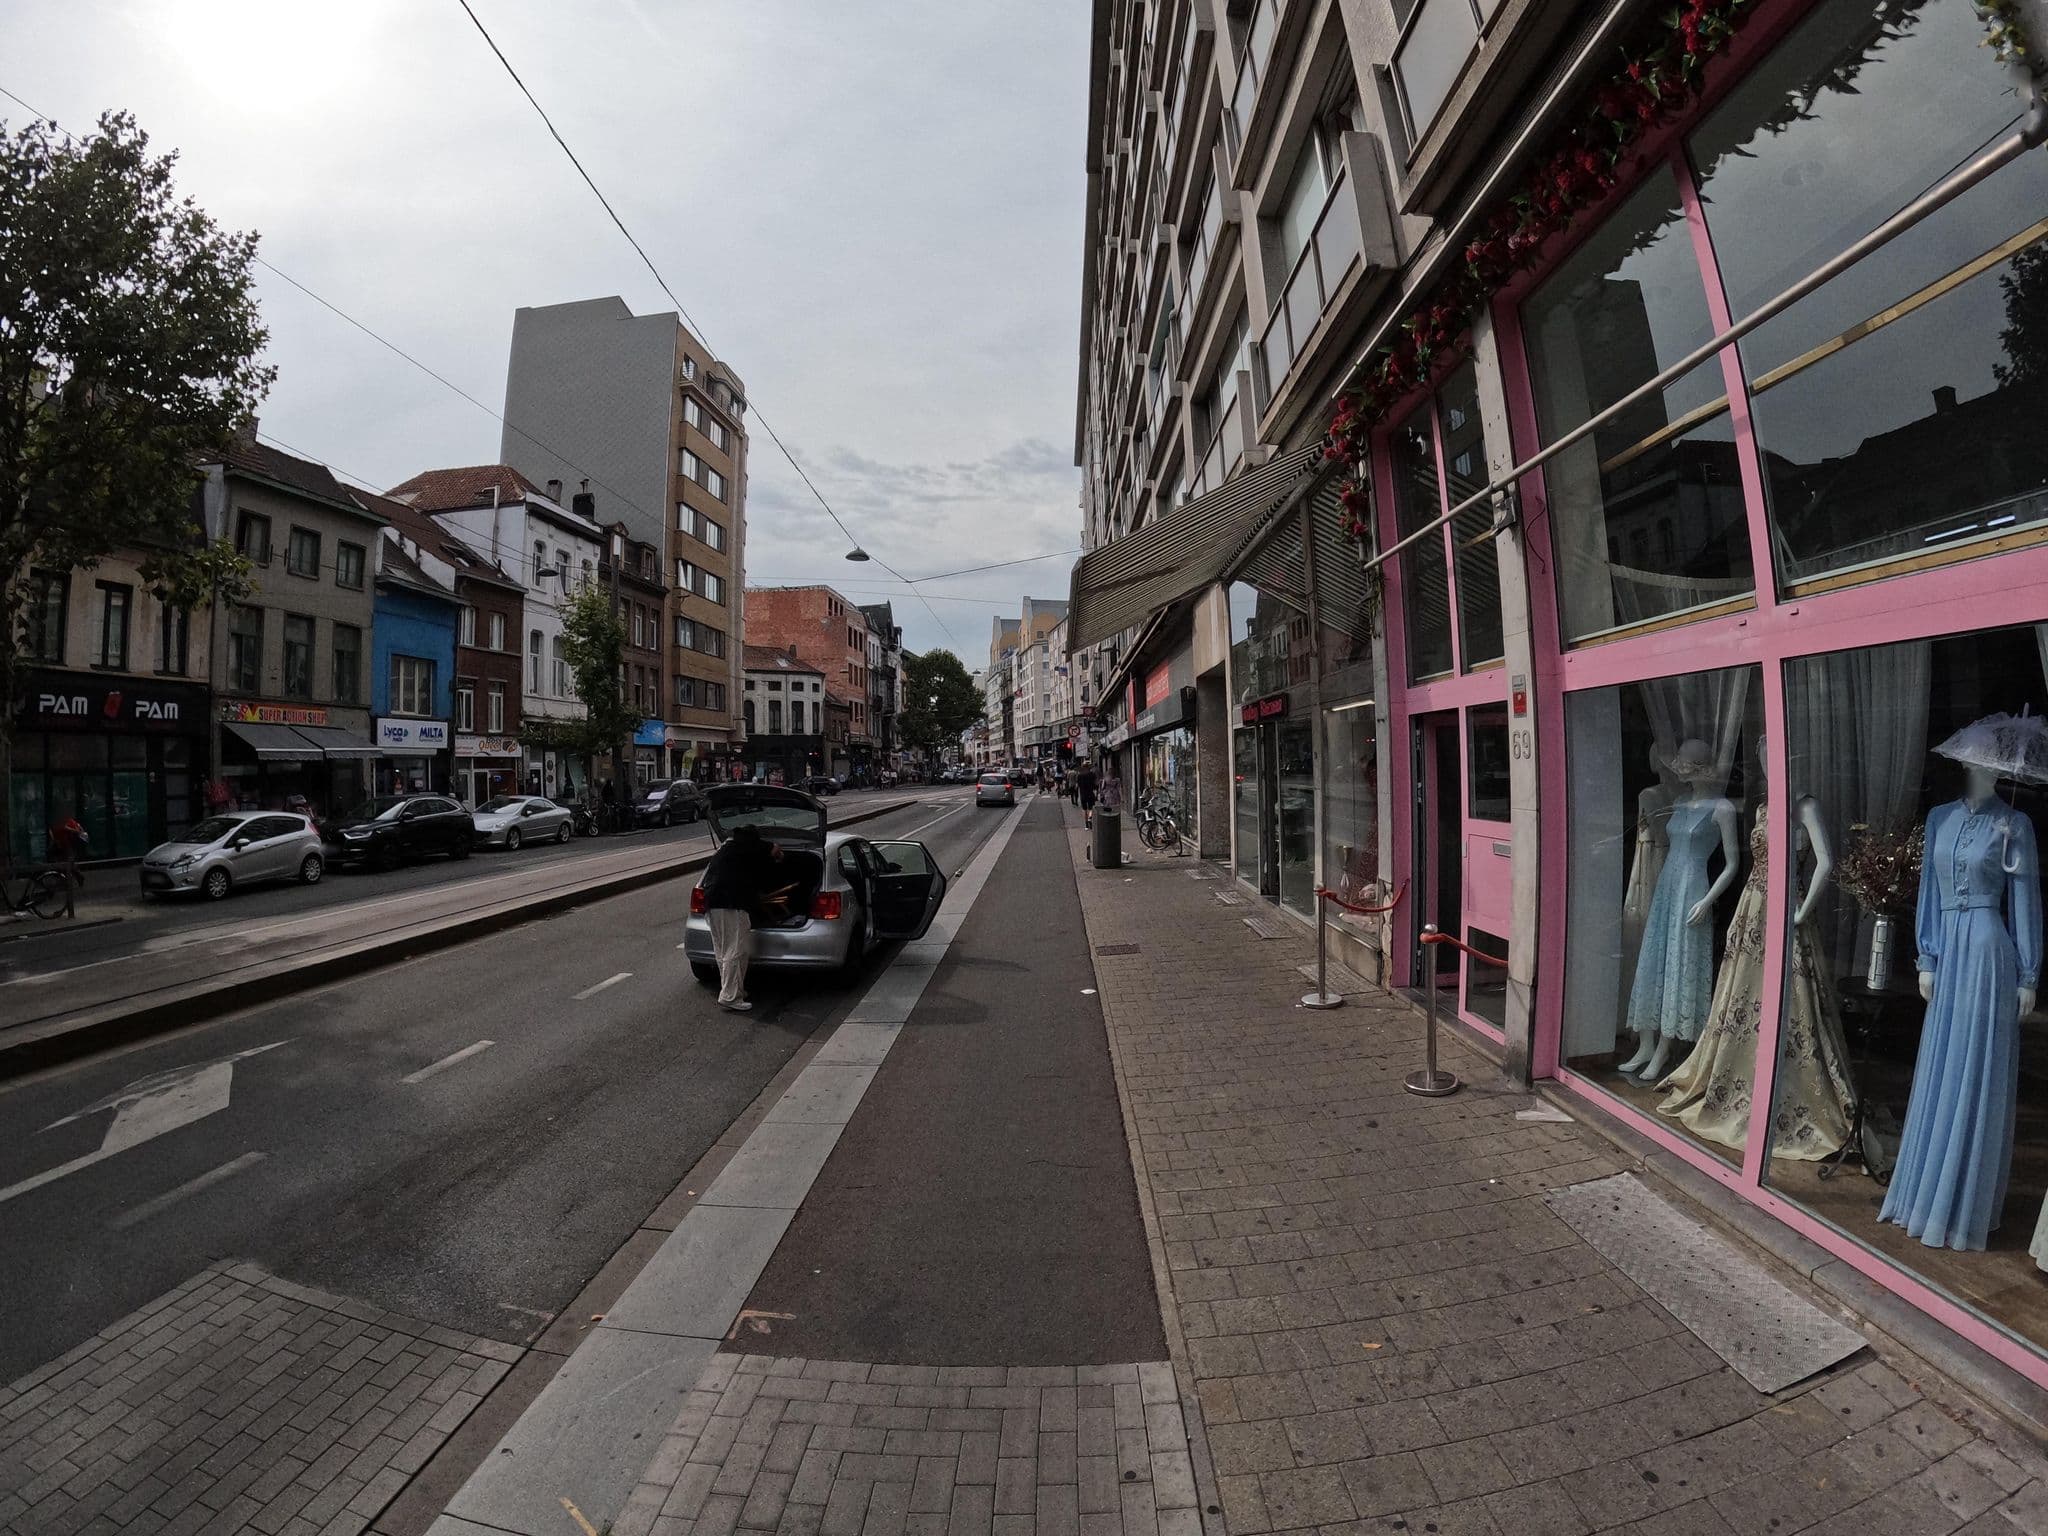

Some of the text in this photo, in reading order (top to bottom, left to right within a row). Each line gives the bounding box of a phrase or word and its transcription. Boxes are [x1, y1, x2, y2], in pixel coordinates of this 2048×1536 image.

[39, 693, 179, 720] PAM PAM
[258, 708, 281, 721] SUPER
[282, 710, 307, 723] ACTION
[420, 727, 443, 738] MILTA
[1513, 731, 1531, 759] 69
